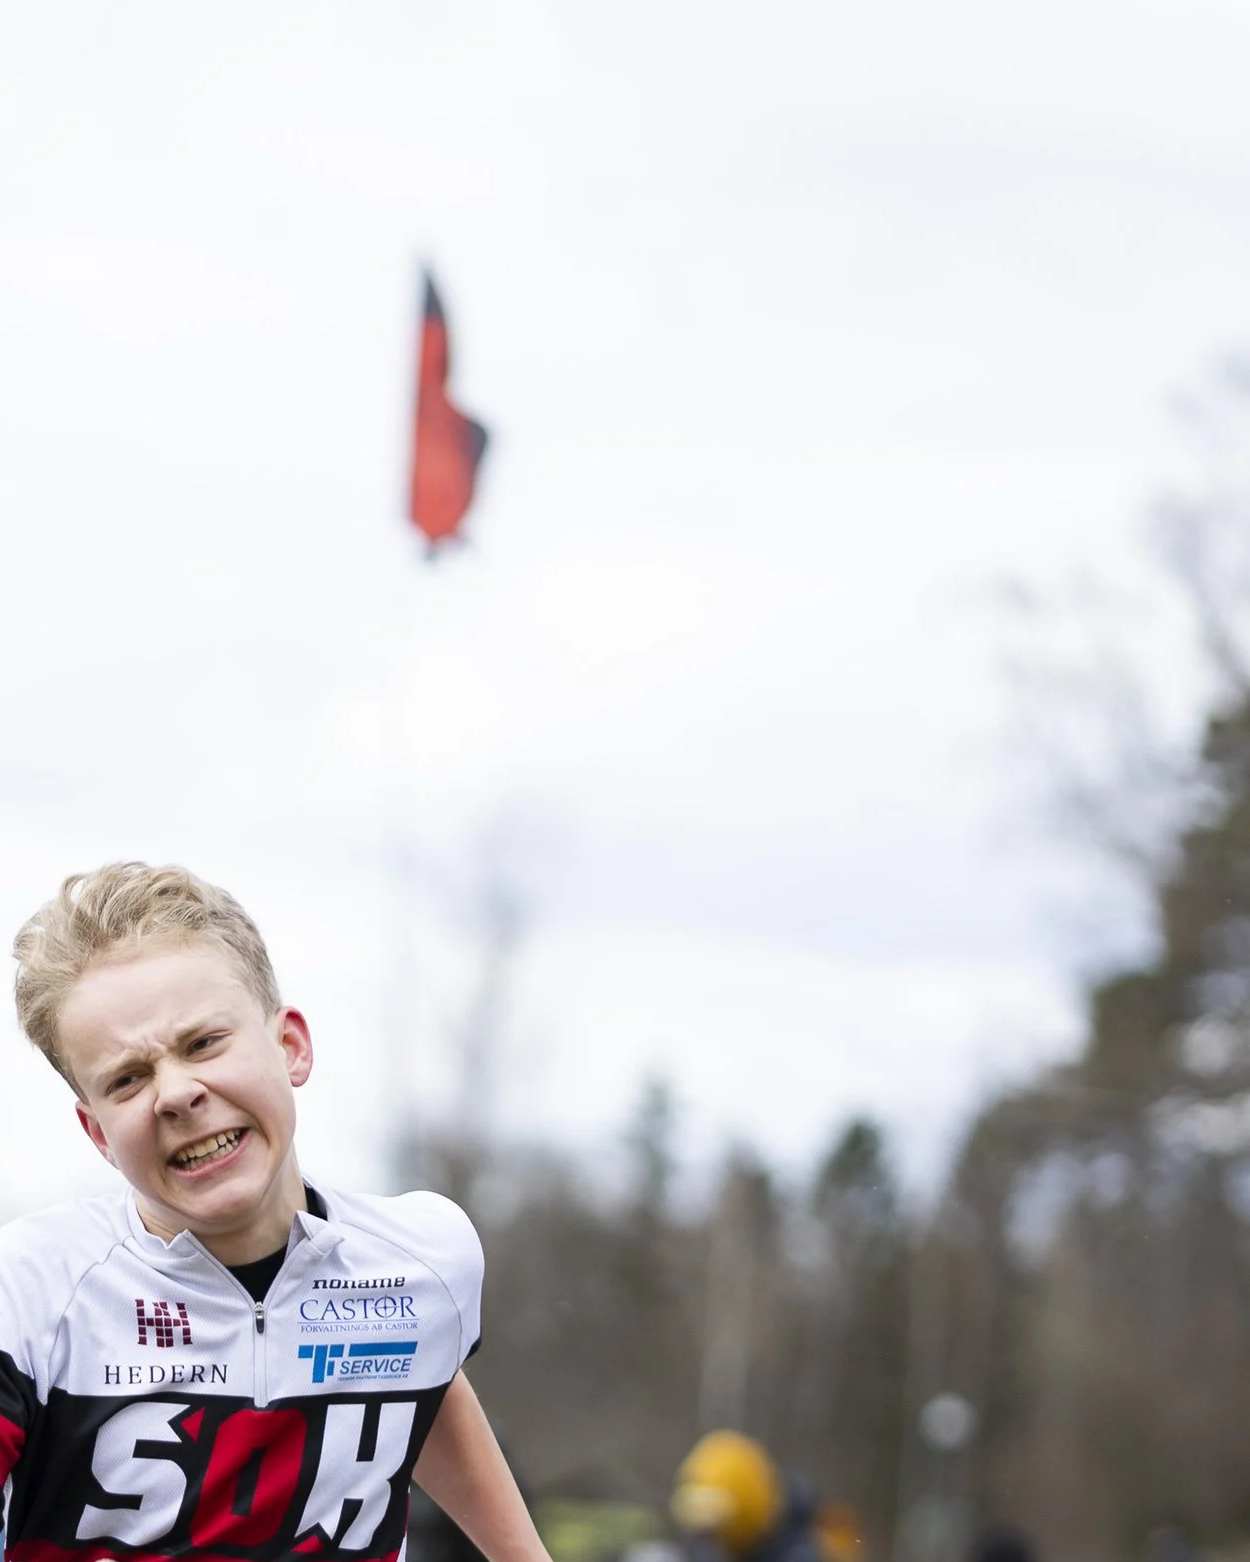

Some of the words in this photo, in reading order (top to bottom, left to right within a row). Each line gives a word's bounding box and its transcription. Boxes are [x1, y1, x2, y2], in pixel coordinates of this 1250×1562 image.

[312, 1277, 405, 1289] noname
[300, 1295, 416, 1321] CASTOR
[104, 1363, 228, 1384] HEDERN
[339, 1357, 413, 1375] SERVICE
